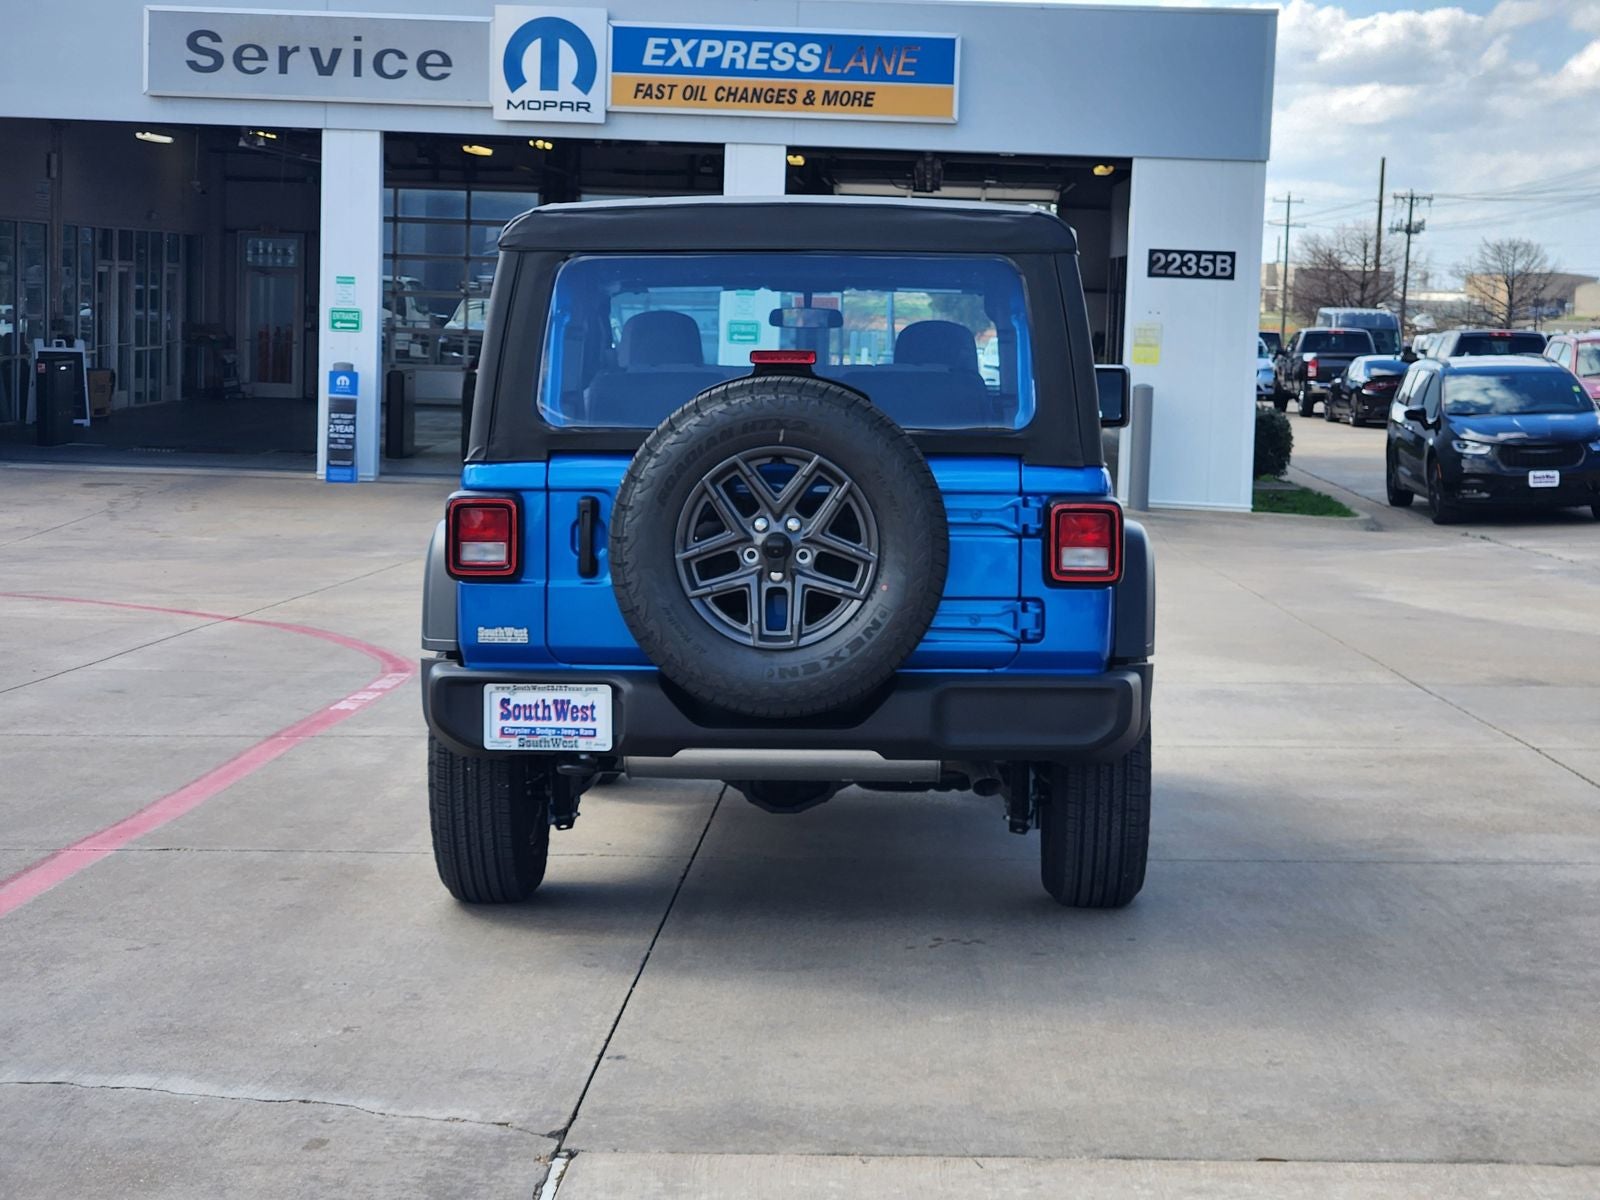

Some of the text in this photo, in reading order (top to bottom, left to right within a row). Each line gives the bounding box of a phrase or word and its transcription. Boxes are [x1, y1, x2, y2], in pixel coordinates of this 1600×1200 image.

[185, 29, 453, 82] Service
[506, 99, 593, 113] MOPAR
[633, 82, 876, 108] FAST OIL CHANGES & MORE
[1151, 252, 1232, 276] 2235B
[332, 311, 359, 321] ENTRANCE
[329, 424, 355, 433] 2-YEAR
[778, 618, 882, 679] NEXEN
[499, 698, 597, 722] SouthWest
[503, 727, 595, 738] Chrysler Dodge Jeep Ram
